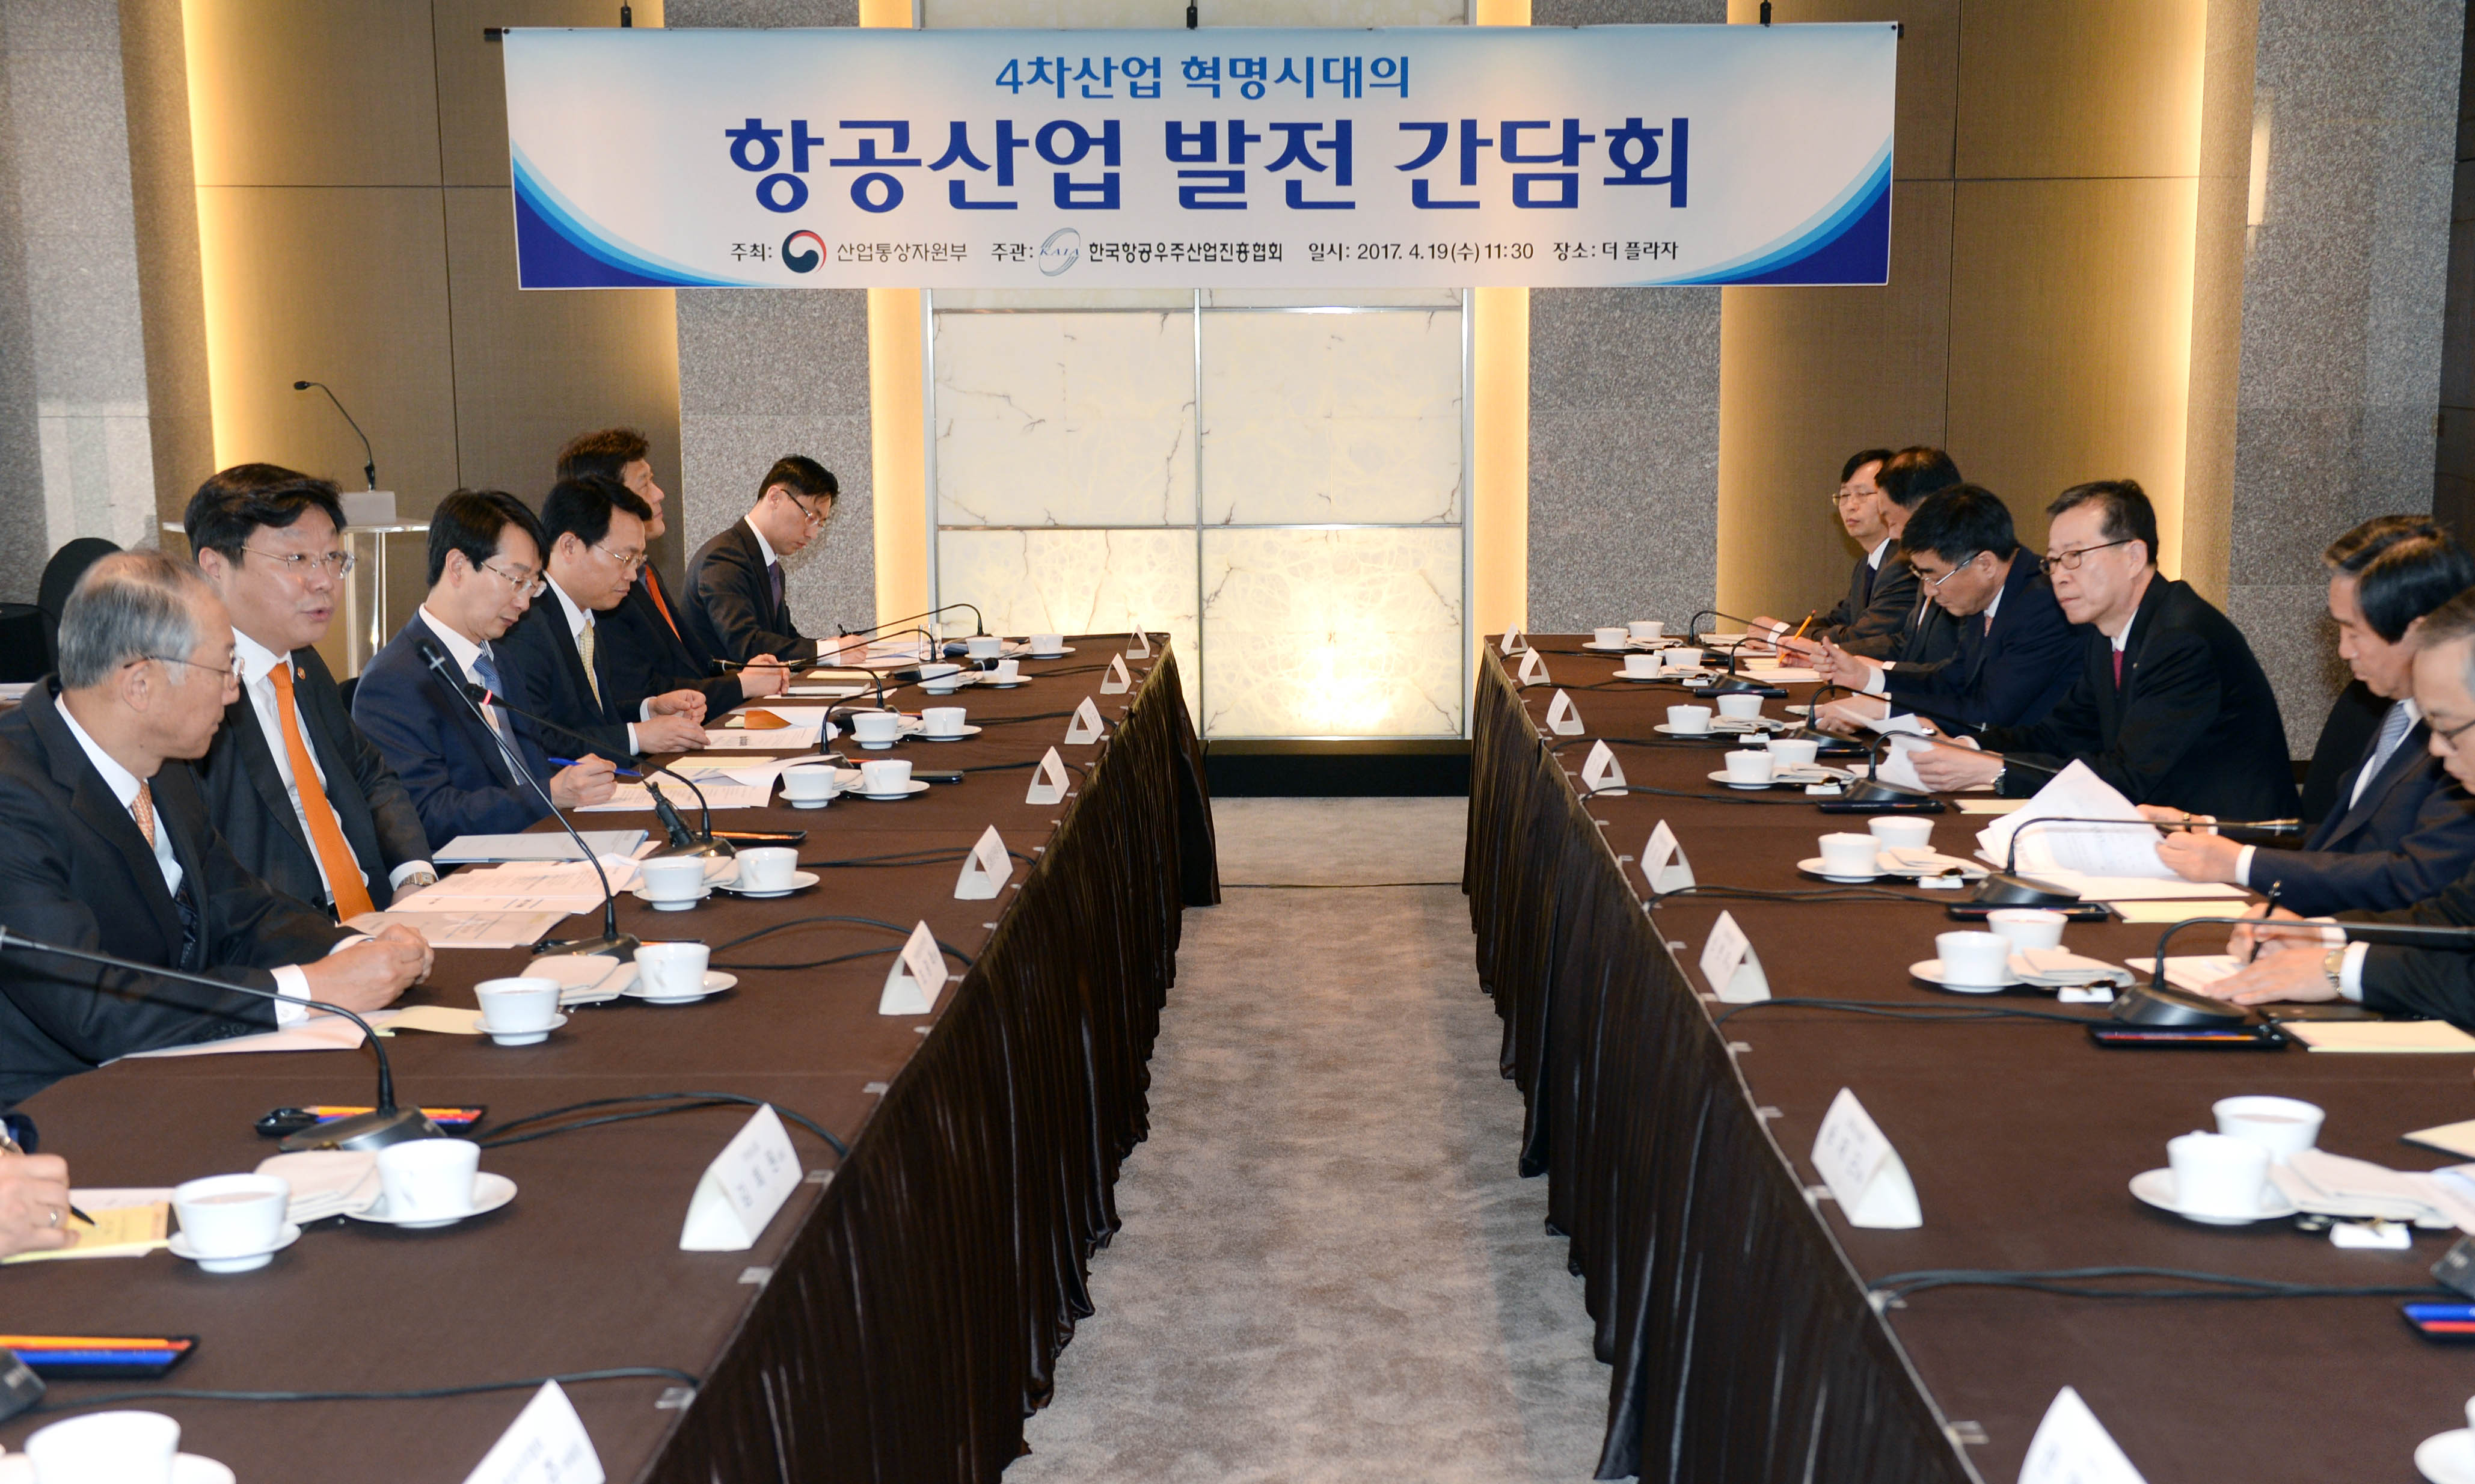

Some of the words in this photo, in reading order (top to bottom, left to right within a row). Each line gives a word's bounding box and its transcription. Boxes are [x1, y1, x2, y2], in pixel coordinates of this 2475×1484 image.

[995, 55, 1162, 99] 4차산업
[1180, 55, 1409, 101] 혁명시대의
[725, 117, 1122, 214] 항공산업
[1164, 118, 1357, 210] 발전
[1394, 117, 1690, 210] 간담회
[730, 242, 773, 262] 주최:
[837, 242, 968, 263] 산업통상자원부
[991, 242, 1034, 262] 주관:
[1088, 241, 1283, 263] 한국항공우주산업진흥협회
[1308, 242, 1351, 262] 일시:
[1553, 242, 1596, 262] 장소:
[1602, 241, 1618, 261] 더
[1624, 241, 1679, 261] 플라자
